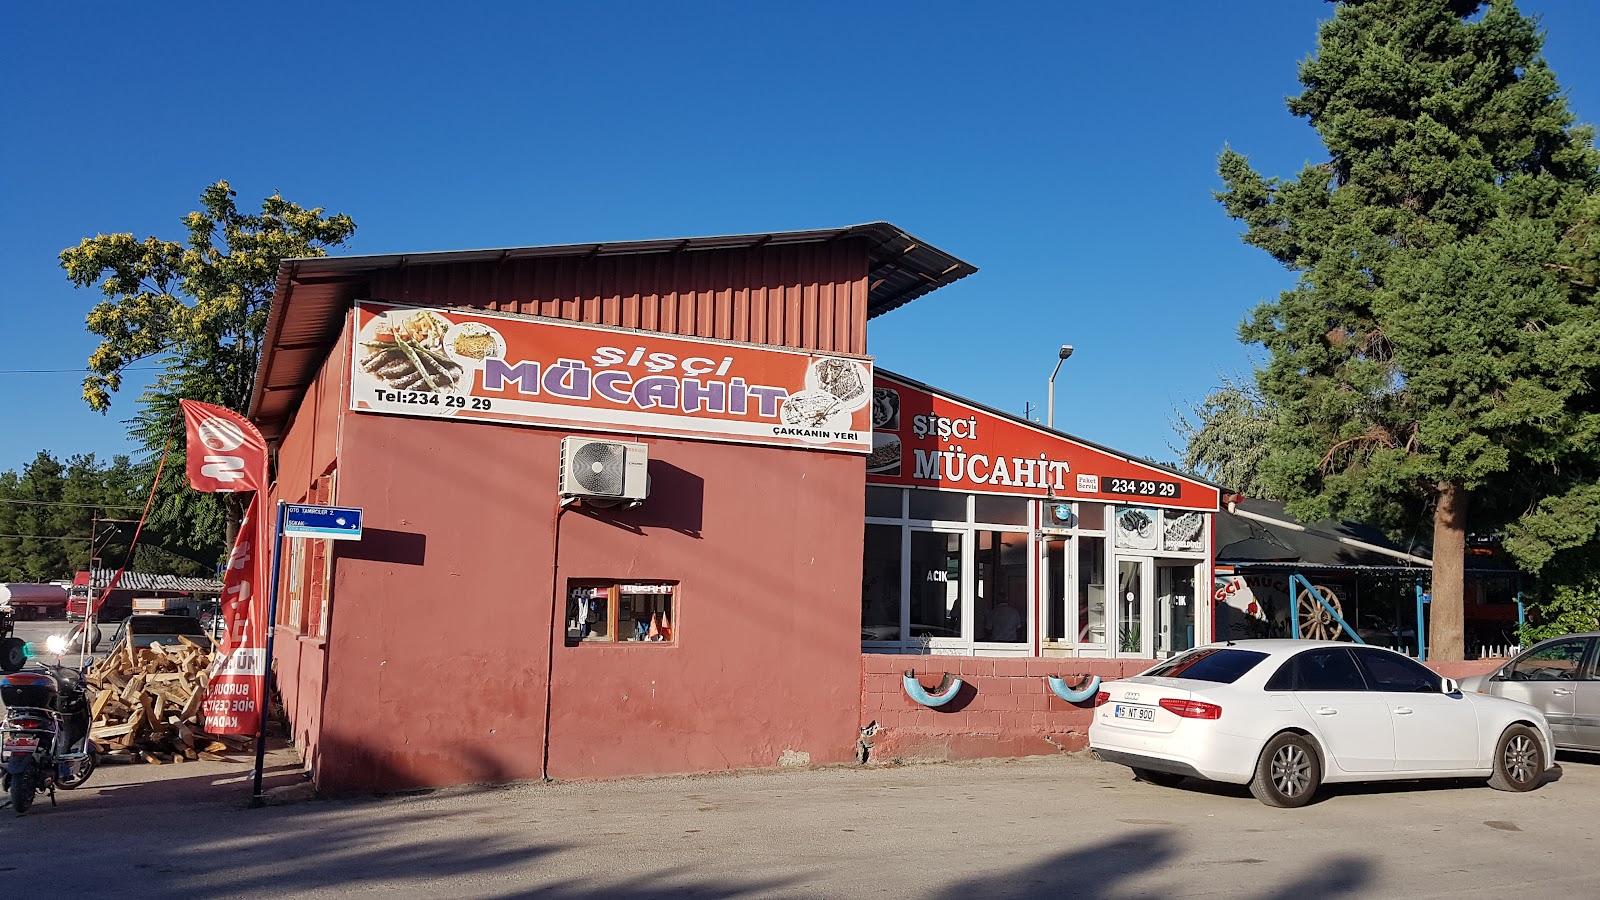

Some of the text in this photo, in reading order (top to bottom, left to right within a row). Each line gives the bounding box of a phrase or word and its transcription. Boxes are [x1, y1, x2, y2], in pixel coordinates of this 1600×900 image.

[482, 357, 789, 418] MÜCAHİT
[374, 389, 492, 411] Tel:234 29 29
[772, 426, 859, 441] ÇAKKANIN YERİ
[912, 444, 1071, 491] MÜCAHİT
[1111, 478, 1176, 497] 234 29 29
[1129, 708, 1138, 718] NT
[1139, 709, 1153, 720] 900
